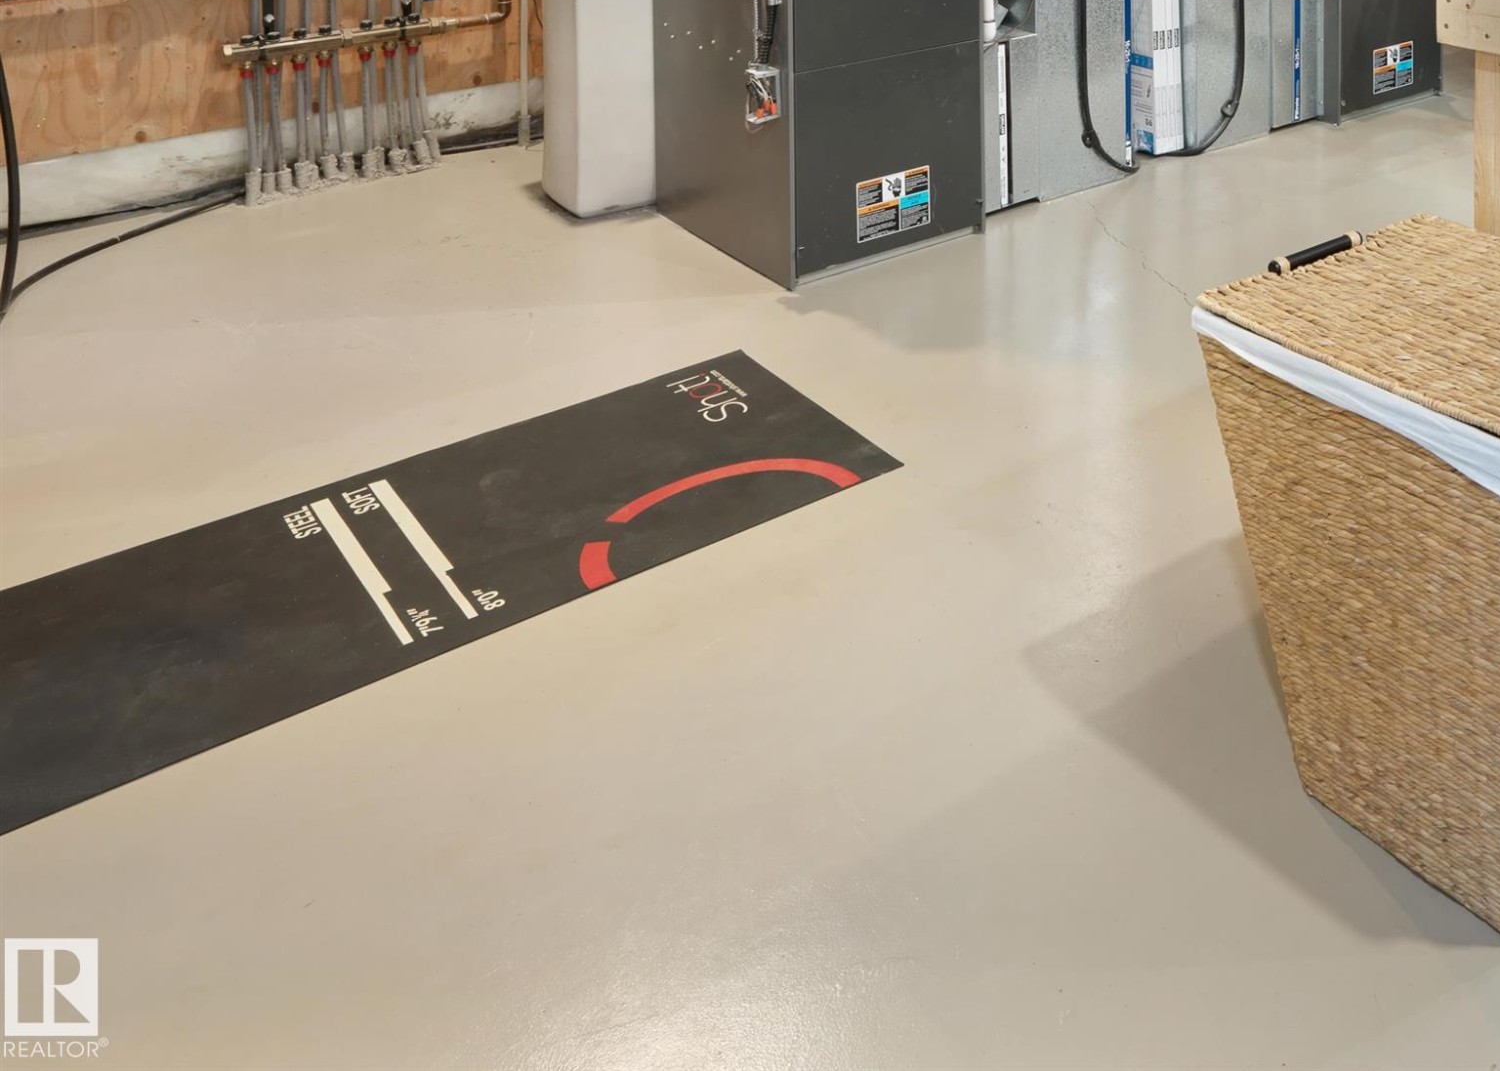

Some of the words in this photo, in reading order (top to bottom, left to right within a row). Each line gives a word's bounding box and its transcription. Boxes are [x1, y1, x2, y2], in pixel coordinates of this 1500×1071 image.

[665, 372, 748, 423] Shot!
[341, 486, 380, 516] SOFT
[282, 505, 323, 540] STEEL
